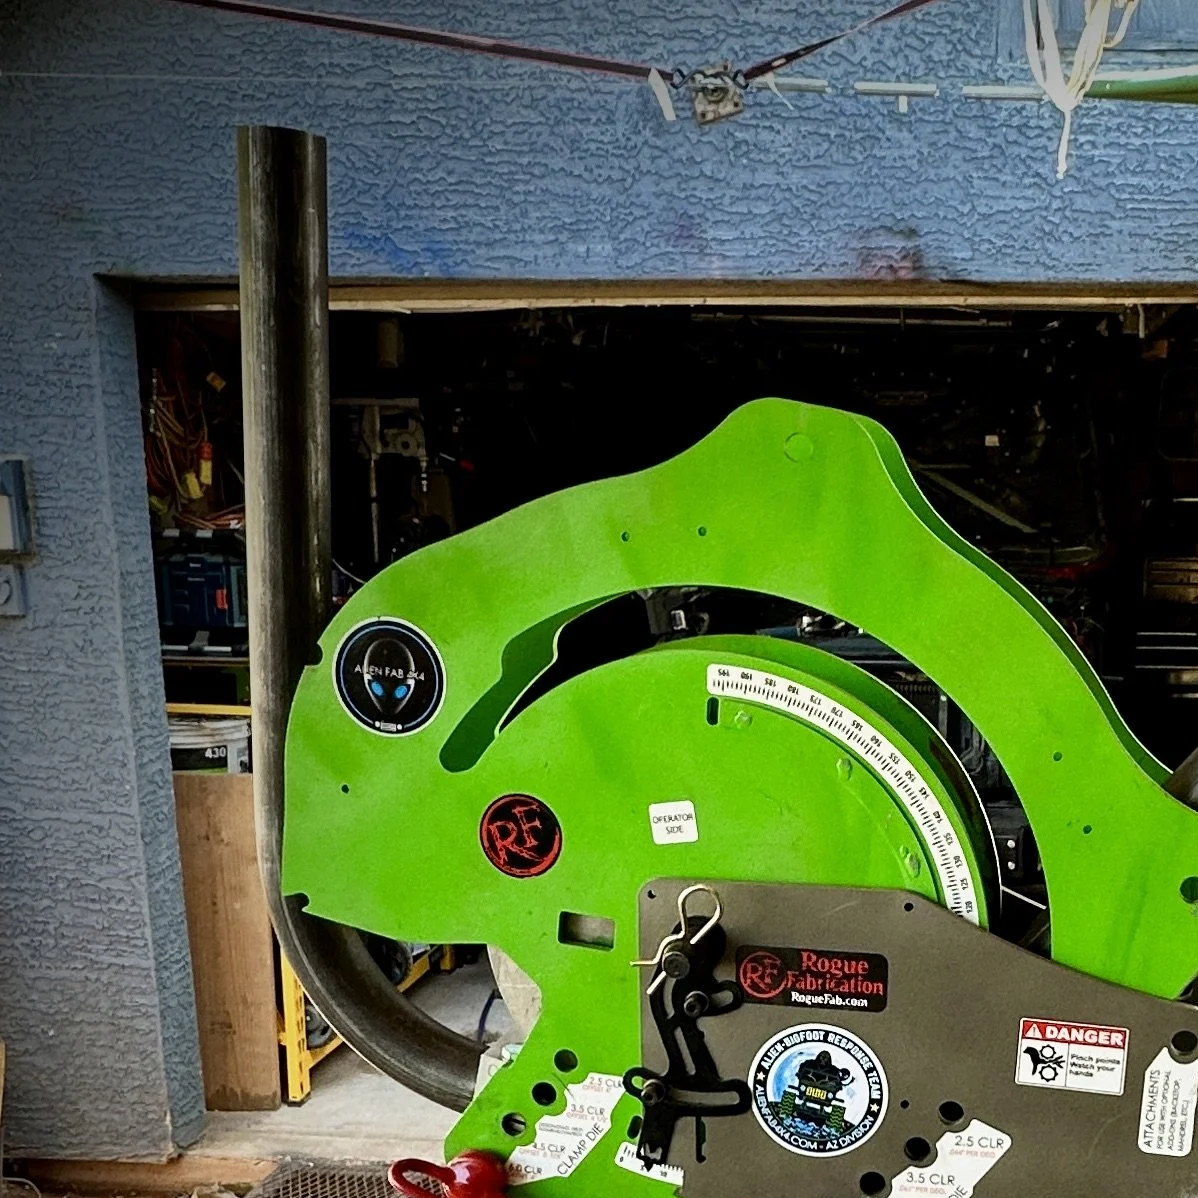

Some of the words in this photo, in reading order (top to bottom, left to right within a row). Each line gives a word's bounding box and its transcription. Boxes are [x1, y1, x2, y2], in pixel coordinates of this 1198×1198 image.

[384, 667, 404, 679] FAB
[204, 746, 227, 758] 430
[652, 813, 694, 824] OPERATOR
[487, 805, 542, 866] RF
[800, 951, 869, 977] Rogue
[744, 958, 781, 991] RF
[784, 970, 884, 995] Fabrication
[791, 991, 868, 1007] RogueFab.com
[1045, 1026, 1123, 1046] DANGER
[827, 1032, 873, 1071] RESPONSE
[867, 1070, 881, 1100] TEAM
[1069, 1061, 1096, 1070] Watch
[1097, 1063, 1115, 1072] your
[1070, 1054, 1094, 1063] Pinch
[1095, 1057, 1121, 1065] points
[590, 1077, 603, 1086] 2.5
[571, 1104, 585, 1113] 3.5
[587, 1106, 605, 1116] CLR
[1144, 1069, 1160, 1148] ATTACHMENTS
[825, 1139, 839, 1150] AZ
[840, 1115, 875, 1145] DIVISION
[533, 1142, 546, 1151] 4.5
[547, 1144, 566, 1154] CLR
[556, 1139, 589, 1175] CLAMP
[585, 1122, 604, 1142] DIE
[955, 1135, 974, 1147] 2.5
[977, 1136, 1005, 1149] CLR
[524, 1165, 543, 1175] CLR
[906, 1172, 925, 1184] 3.5
[929, 1173, 955, 1185] CLR
